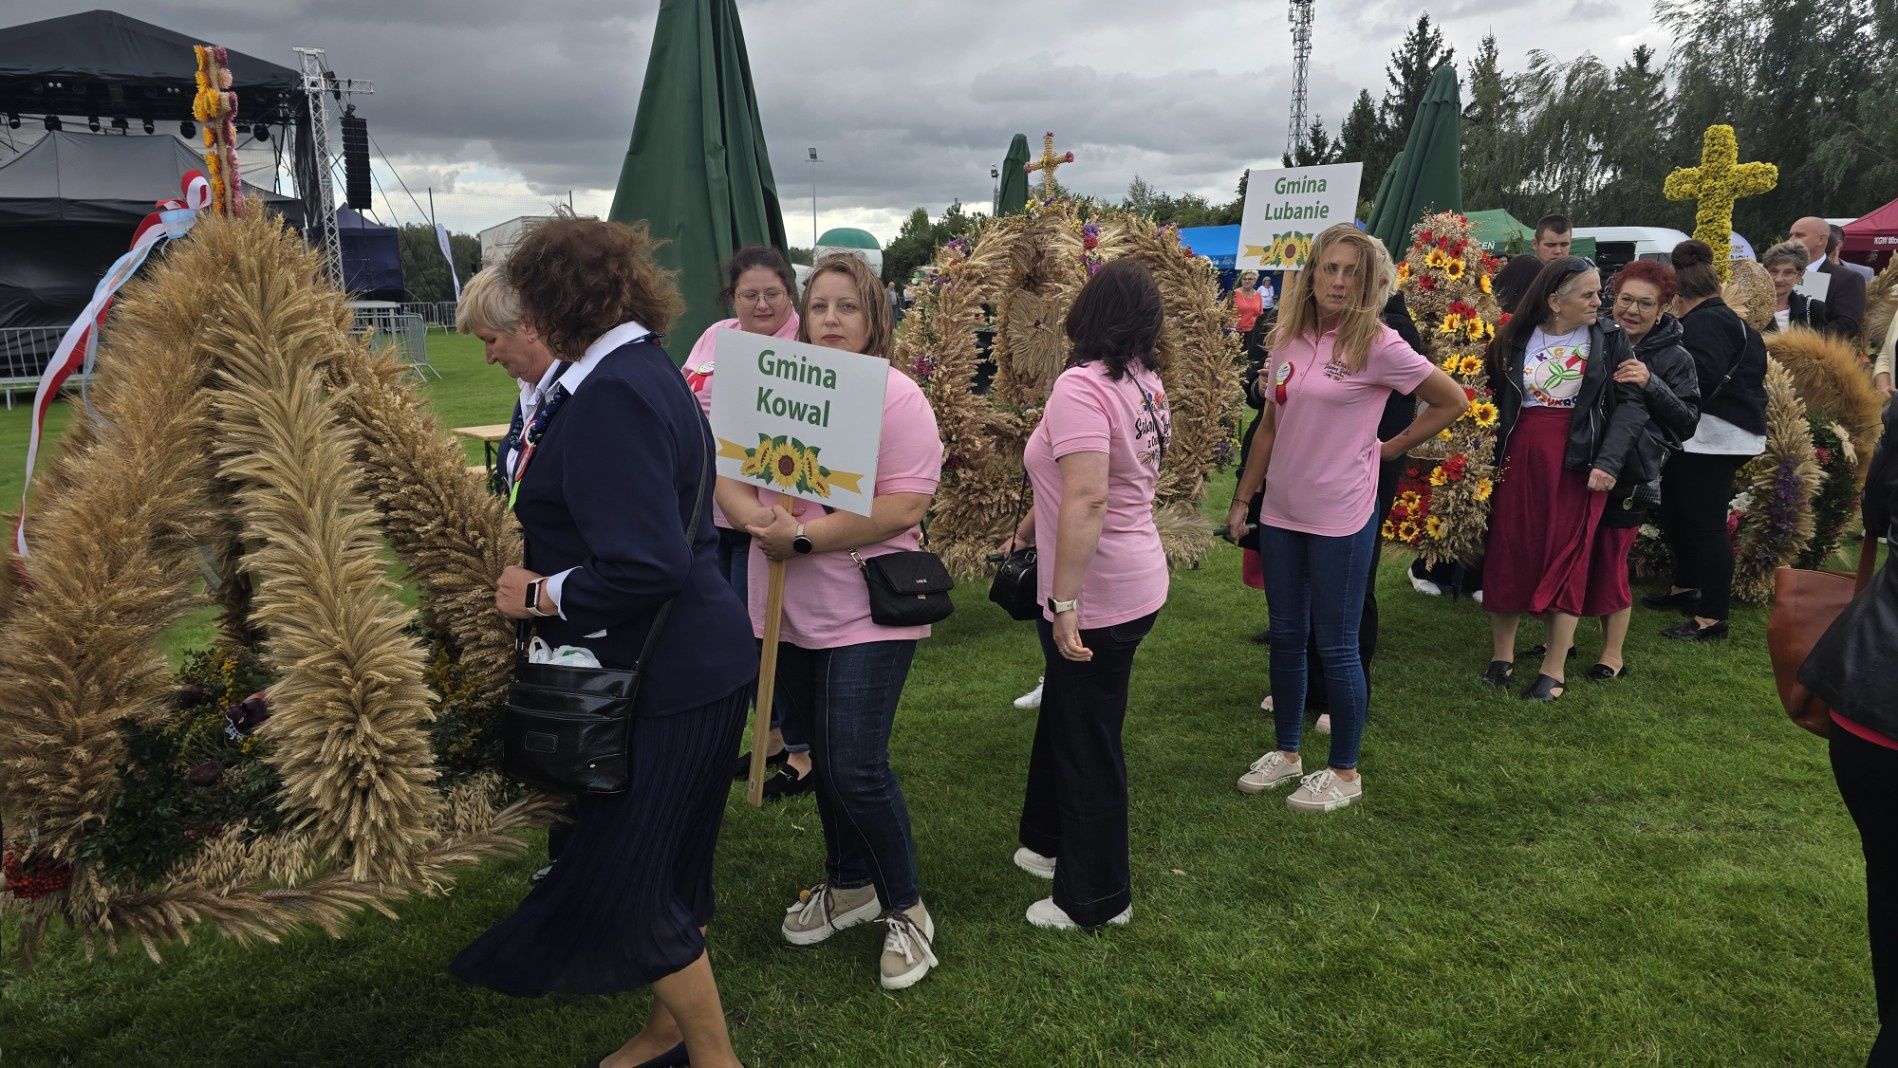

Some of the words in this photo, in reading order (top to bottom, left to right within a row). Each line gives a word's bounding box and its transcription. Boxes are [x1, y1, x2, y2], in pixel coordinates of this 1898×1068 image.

[1274, 174, 1327, 195] Gmina
[1264, 200, 1330, 221] Lubanie
[757, 349, 837, 390] Gmina
[756, 386, 831, 428] Kowal
